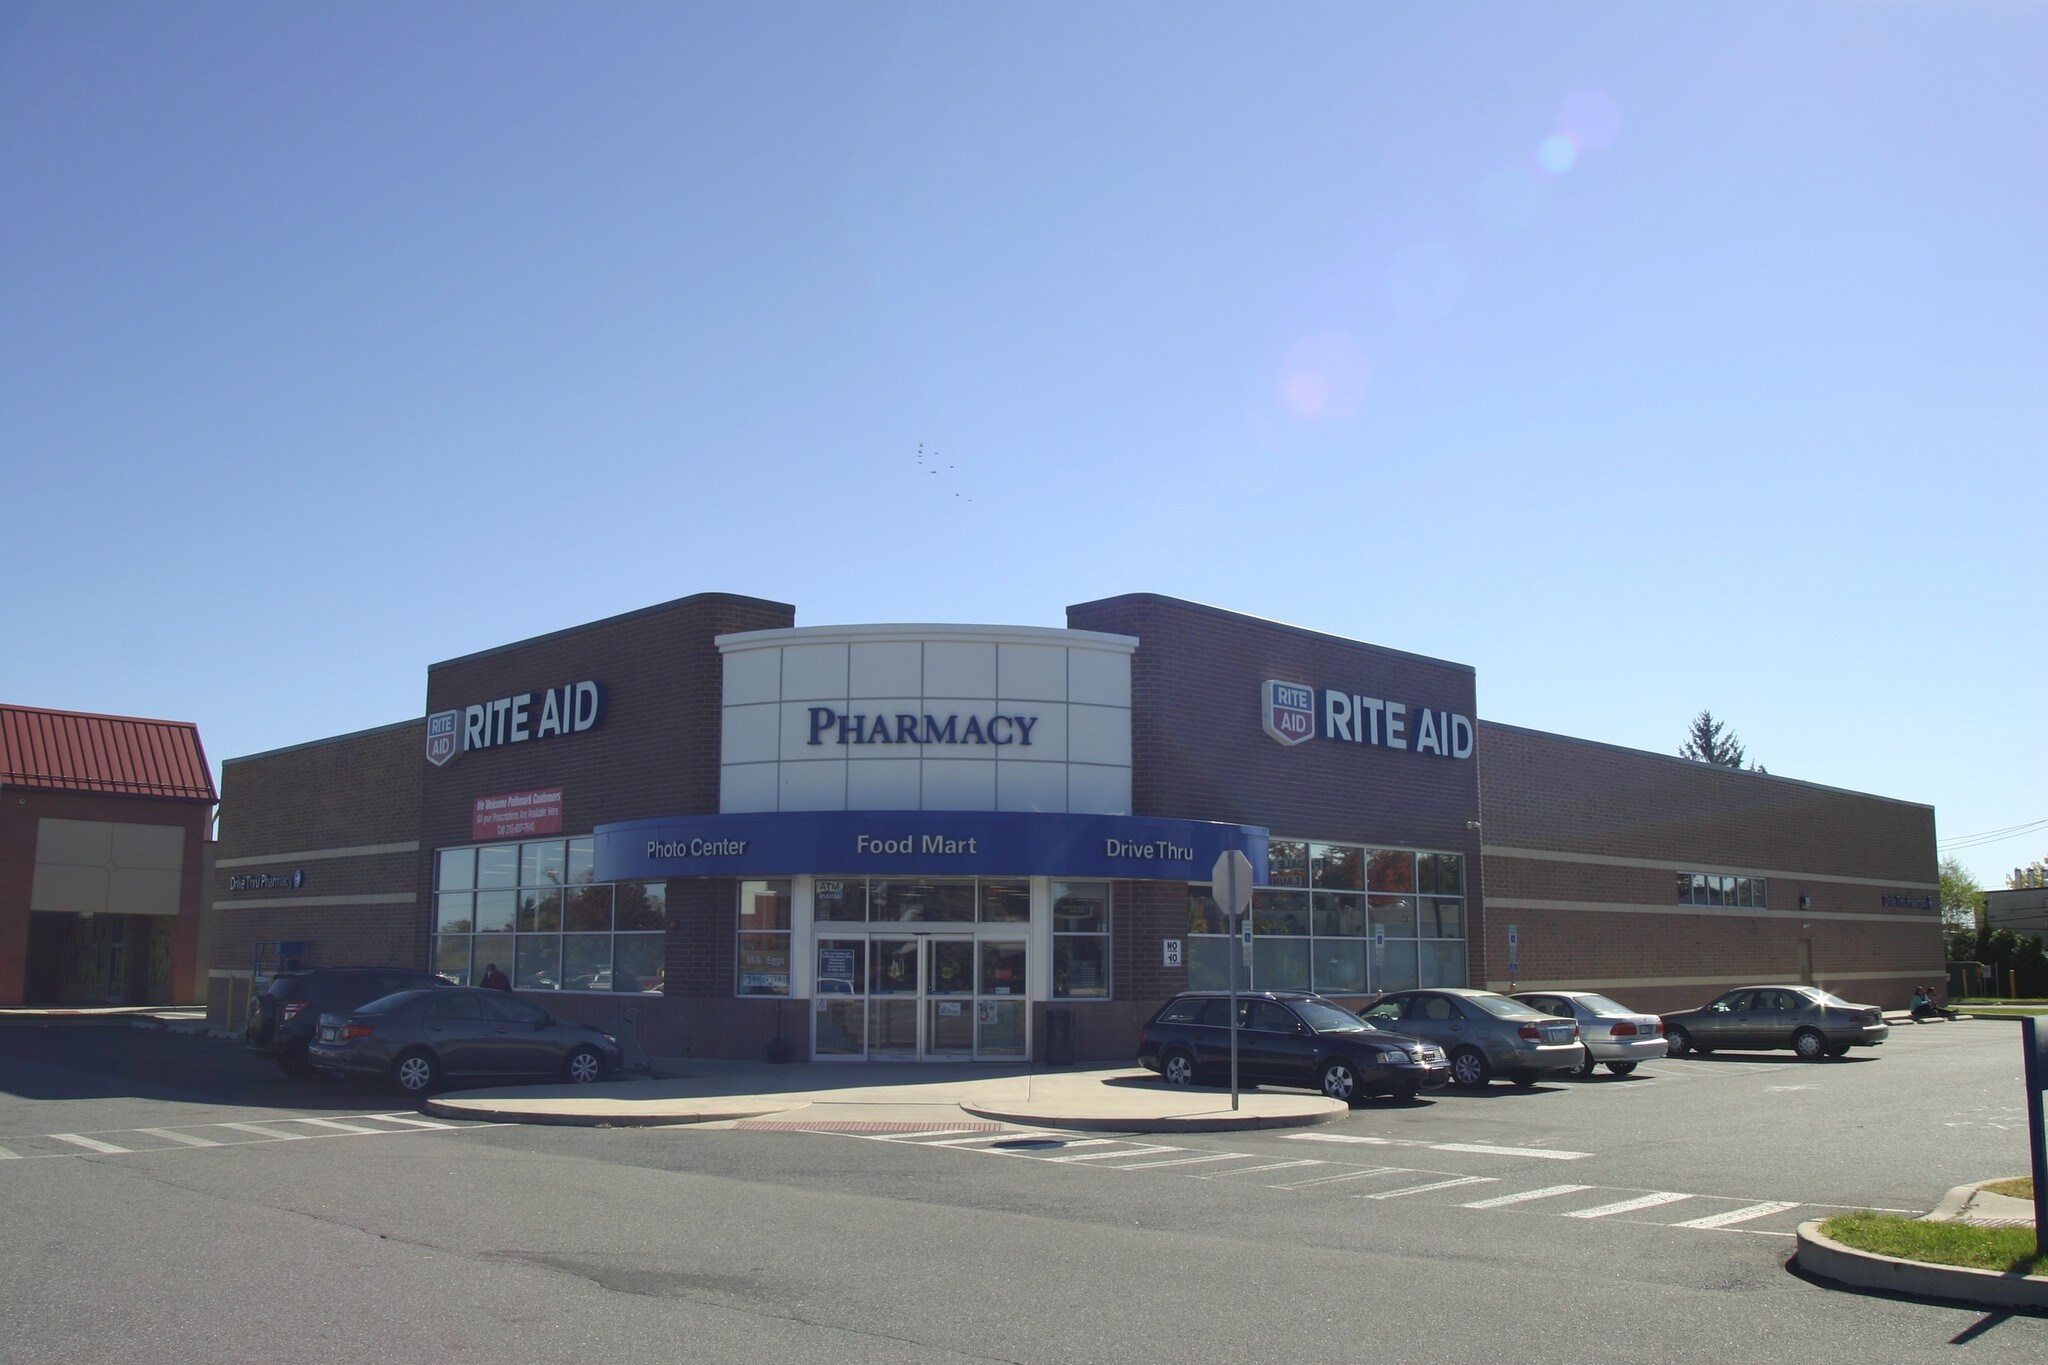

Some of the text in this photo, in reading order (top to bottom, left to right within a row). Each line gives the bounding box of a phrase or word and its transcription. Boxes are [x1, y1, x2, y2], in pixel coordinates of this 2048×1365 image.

[1278, 687, 1308, 709] RITE
[432, 715, 452, 734] RITE
[463, 680, 598, 751] RITE AID
[1280, 712, 1306, 733] AID
[1325, 689, 1474, 759] RITE AID
[806, 707, 1038, 746] PHARMACY
[432, 737, 450, 756] AID
[485, 798, 507, 811] Welcome
[532, 792, 561, 804] Customers
[547, 806, 559, 816] Here
[647, 838, 747, 859] Photo Center
[857, 834, 977, 854] Food Mart
[1105, 838, 1194, 861] Drive Thru
[230, 874, 293, 890] Drive Thru Pharmacy
[820, 882, 840, 891] ATM
[1167, 941, 1178, 950] NO
[747, 955, 763, 965] Milk
